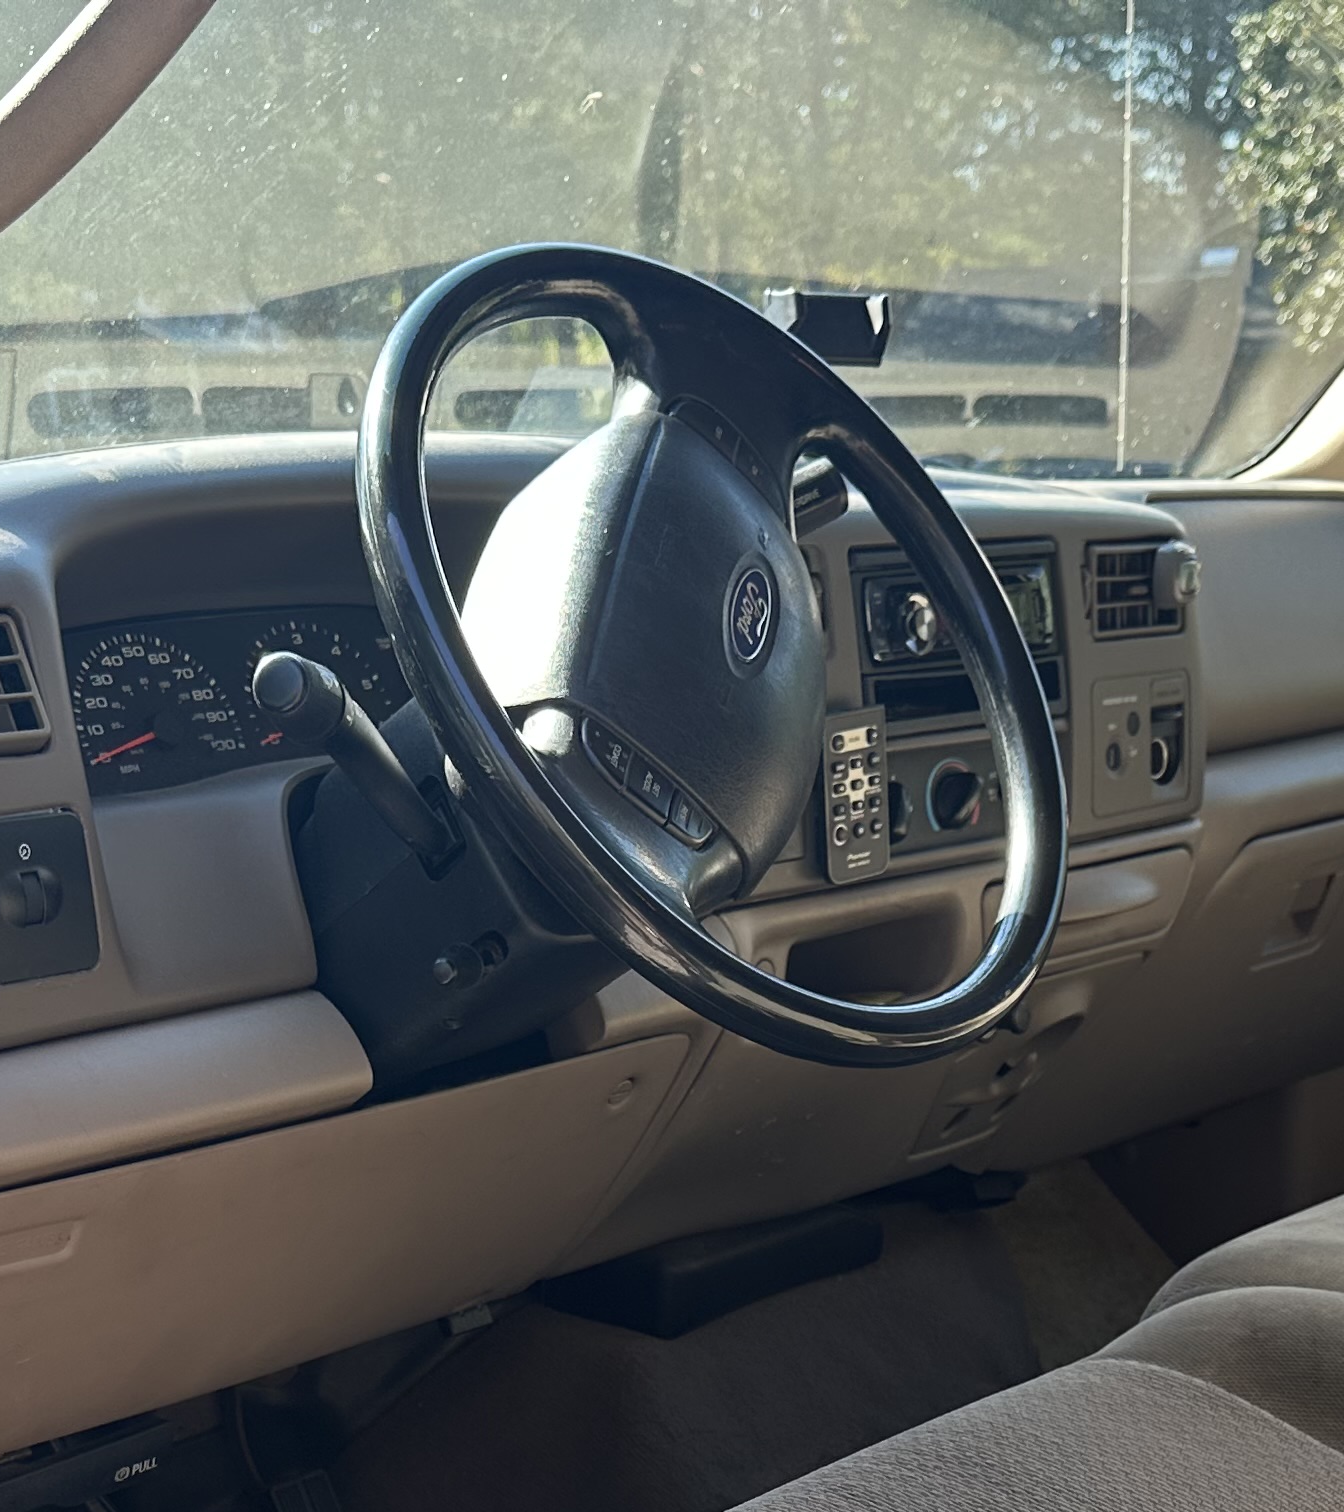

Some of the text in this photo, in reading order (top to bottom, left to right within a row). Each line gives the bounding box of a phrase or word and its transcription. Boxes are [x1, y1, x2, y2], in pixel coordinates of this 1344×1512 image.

[737, 582, 768, 645] Ford
[291, 633, 303, 645] 3
[121, 645, 145, 658] 50
[331, 645, 342, 656] 4
[101, 655, 124, 667] 40
[147, 652, 171, 665] 60
[172, 667, 195, 680] 70
[89, 674, 114, 687] 30
[191, 688, 214, 701] 80
[84, 697, 108, 709] 20
[205, 710, 228, 723] 90
[87, 724, 104, 736] 10
[210, 738, 237, 751] 100
[119, 764, 141, 774] MPH
[131, 1456, 158, 1476] PULL
